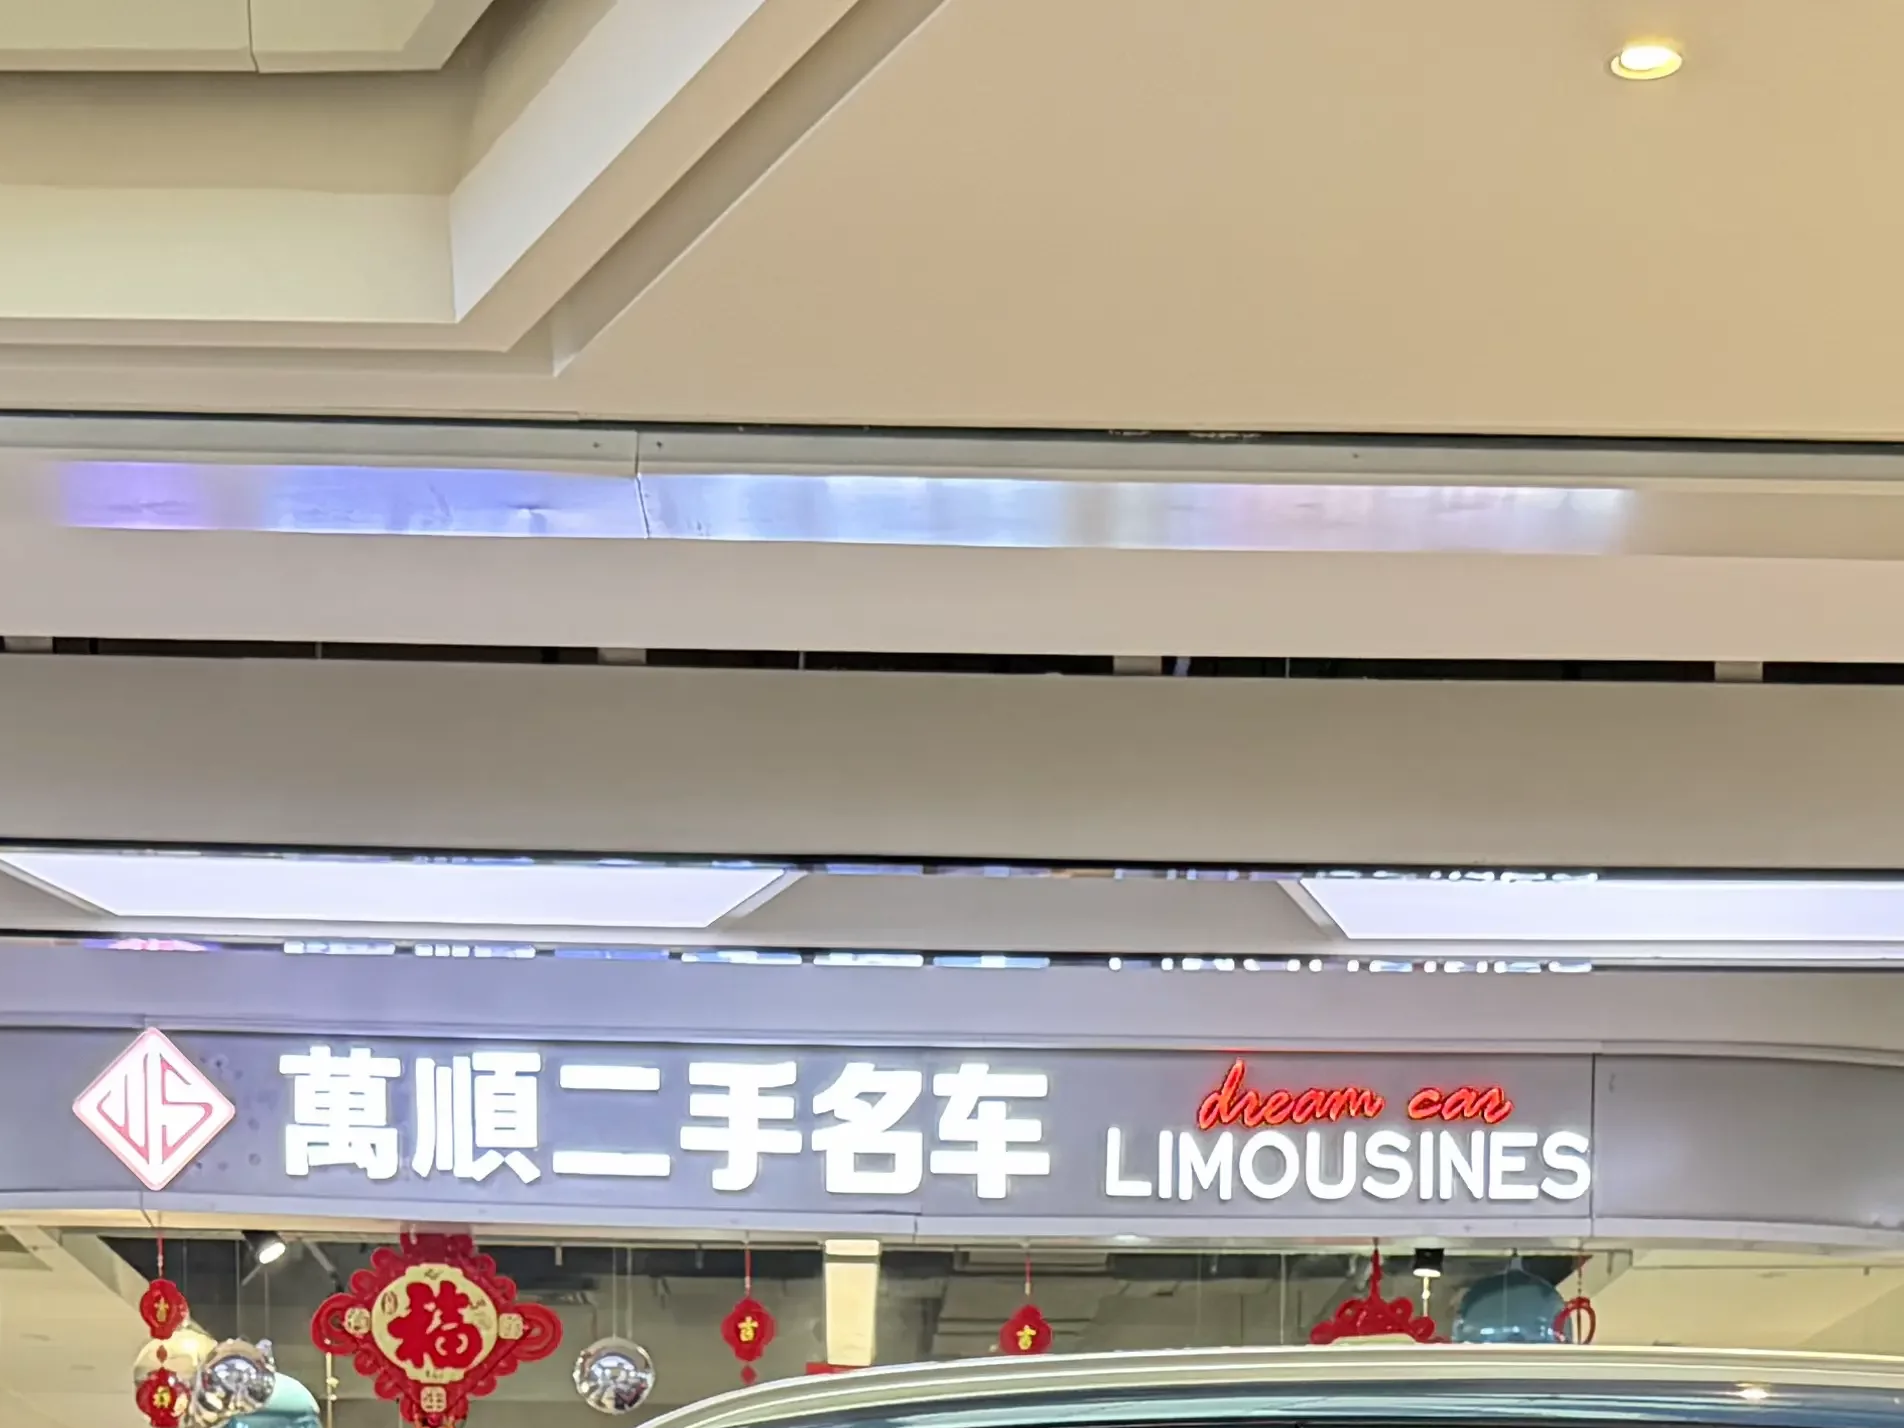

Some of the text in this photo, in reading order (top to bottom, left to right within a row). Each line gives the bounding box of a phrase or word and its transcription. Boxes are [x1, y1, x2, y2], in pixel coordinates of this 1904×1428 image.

[278, 1045, 1051, 1199] 萬順二手名车
[1197, 1057, 1514, 1130] dream car
[1105, 1126, 1591, 1200] LIMOUSINES
[387, 1280, 483, 1369] 福
